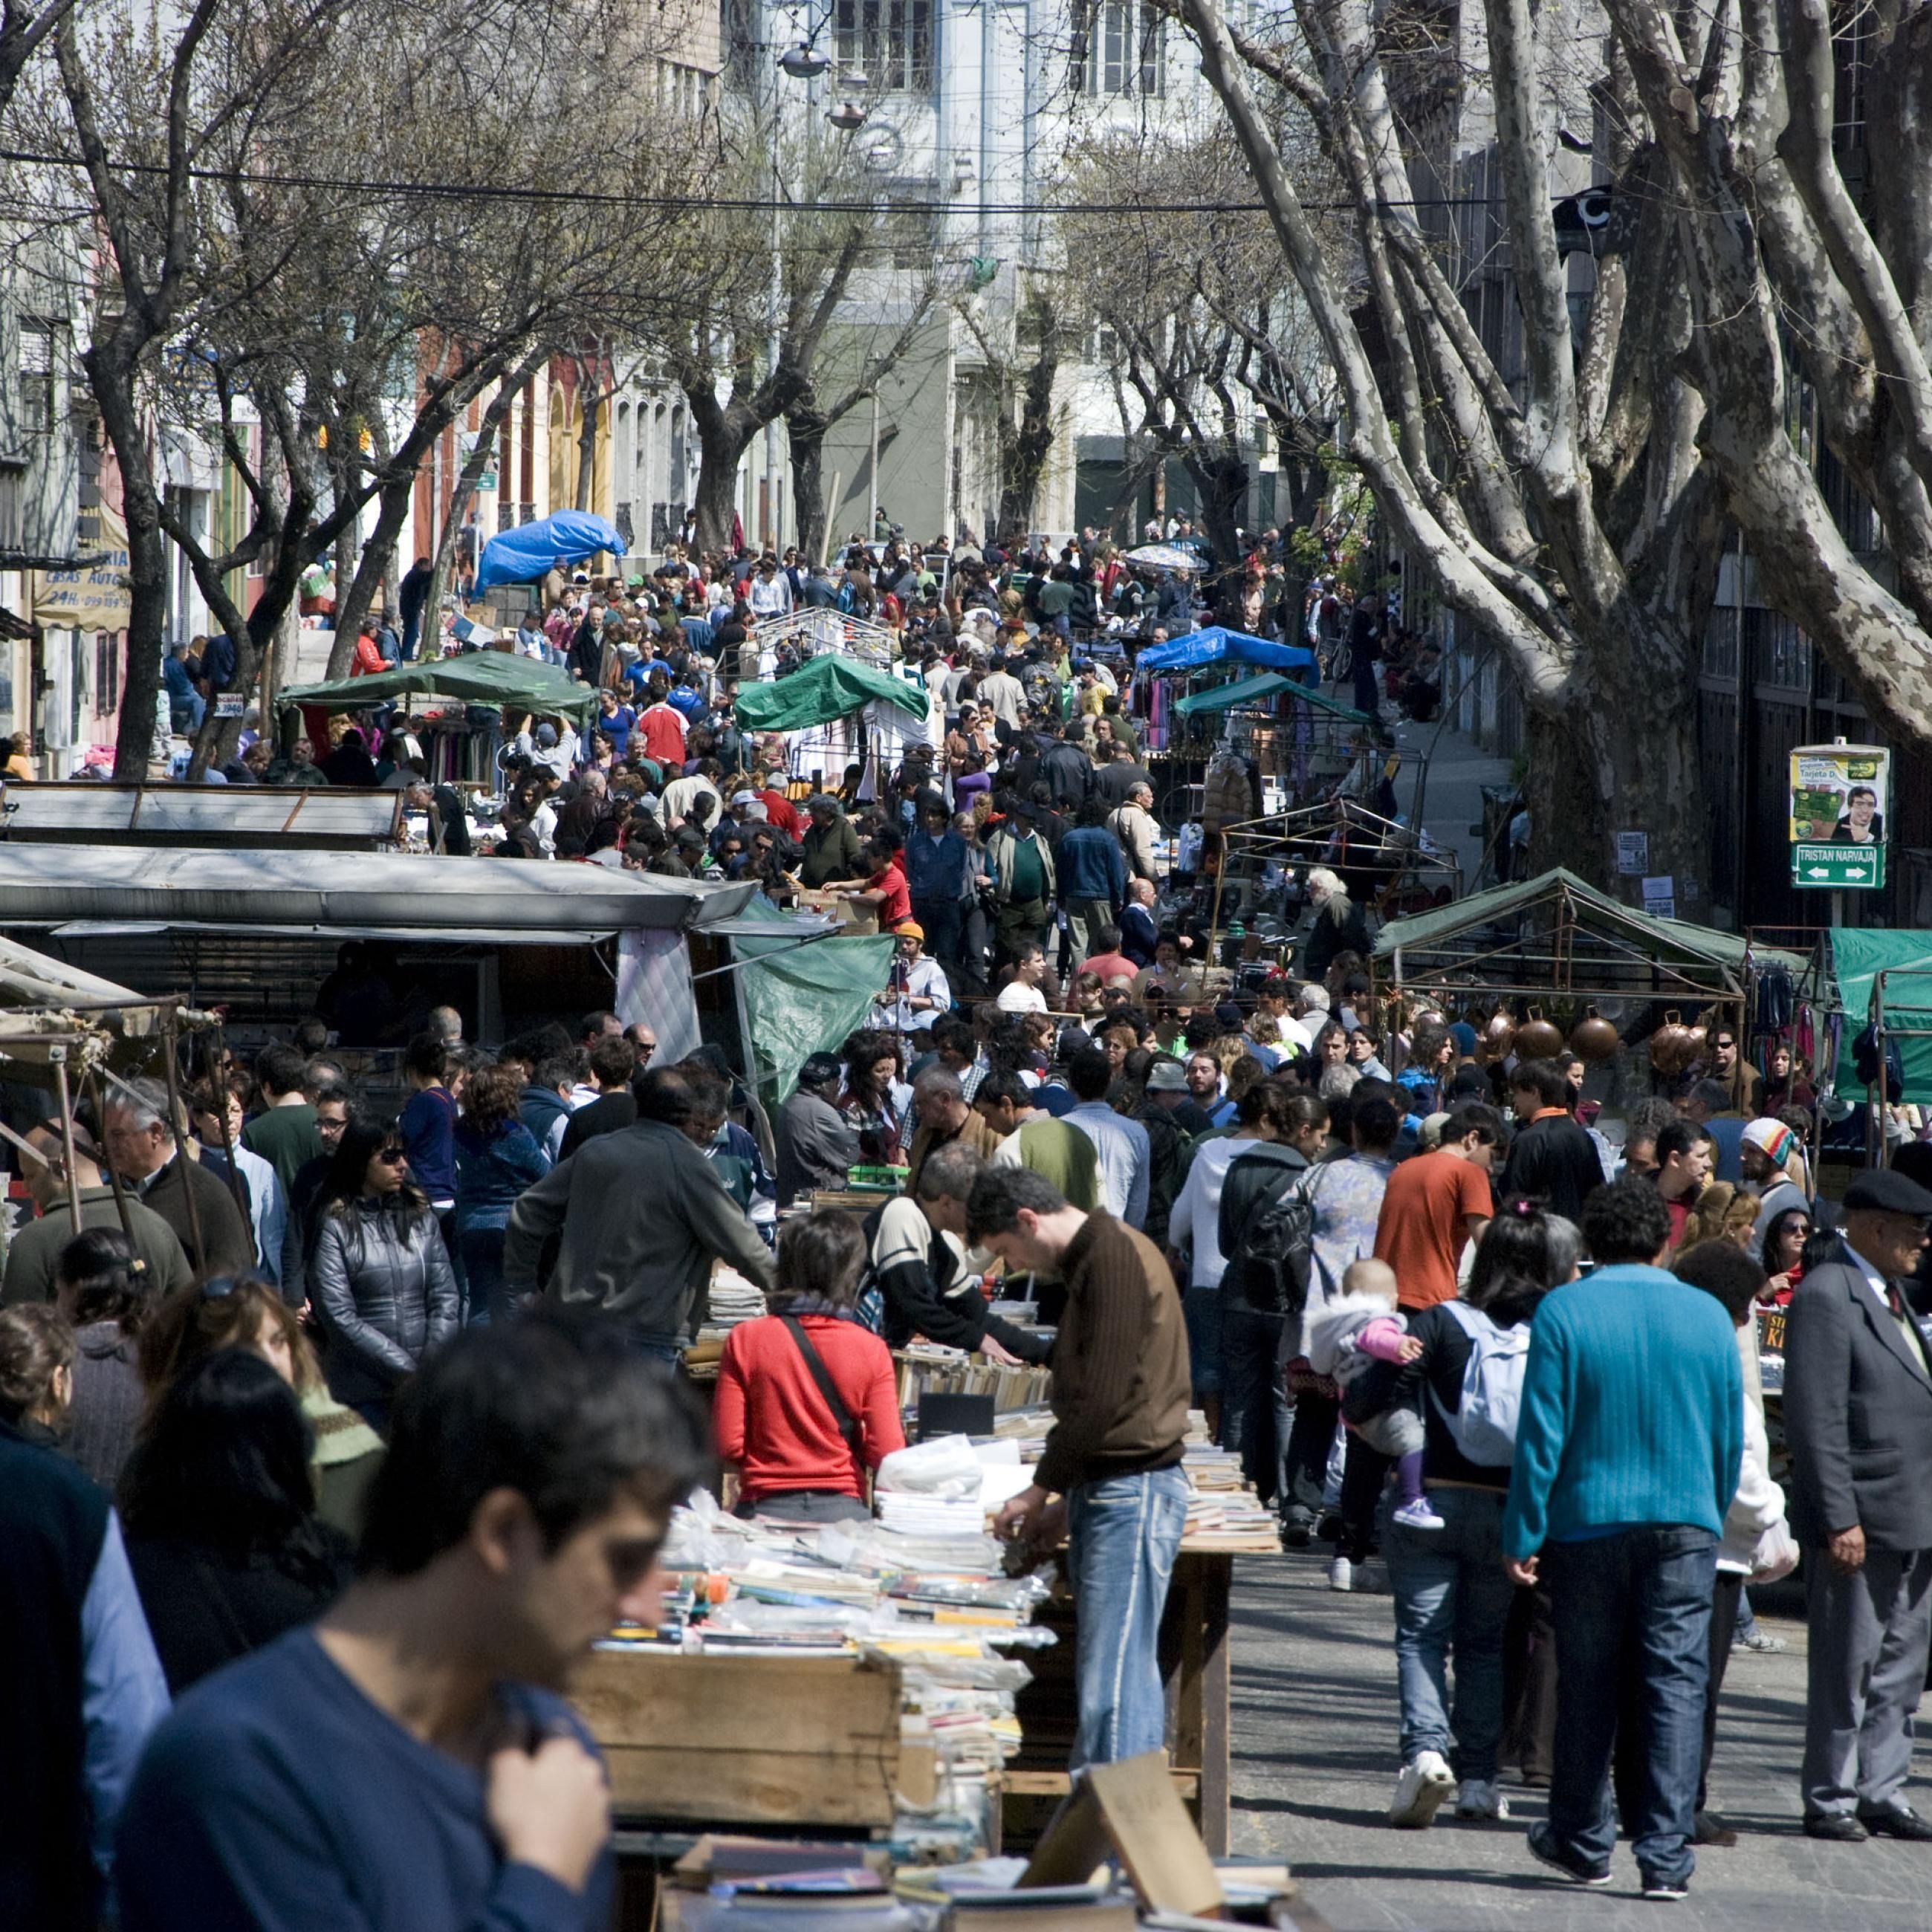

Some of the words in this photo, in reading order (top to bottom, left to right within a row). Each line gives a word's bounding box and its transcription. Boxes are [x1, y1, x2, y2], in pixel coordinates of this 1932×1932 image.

[1800, 770, 1827, 779] Tarjeta
[1800, 849, 1834, 861] TRISTAN
[1835, 851, 1874, 863] NARVAJA
